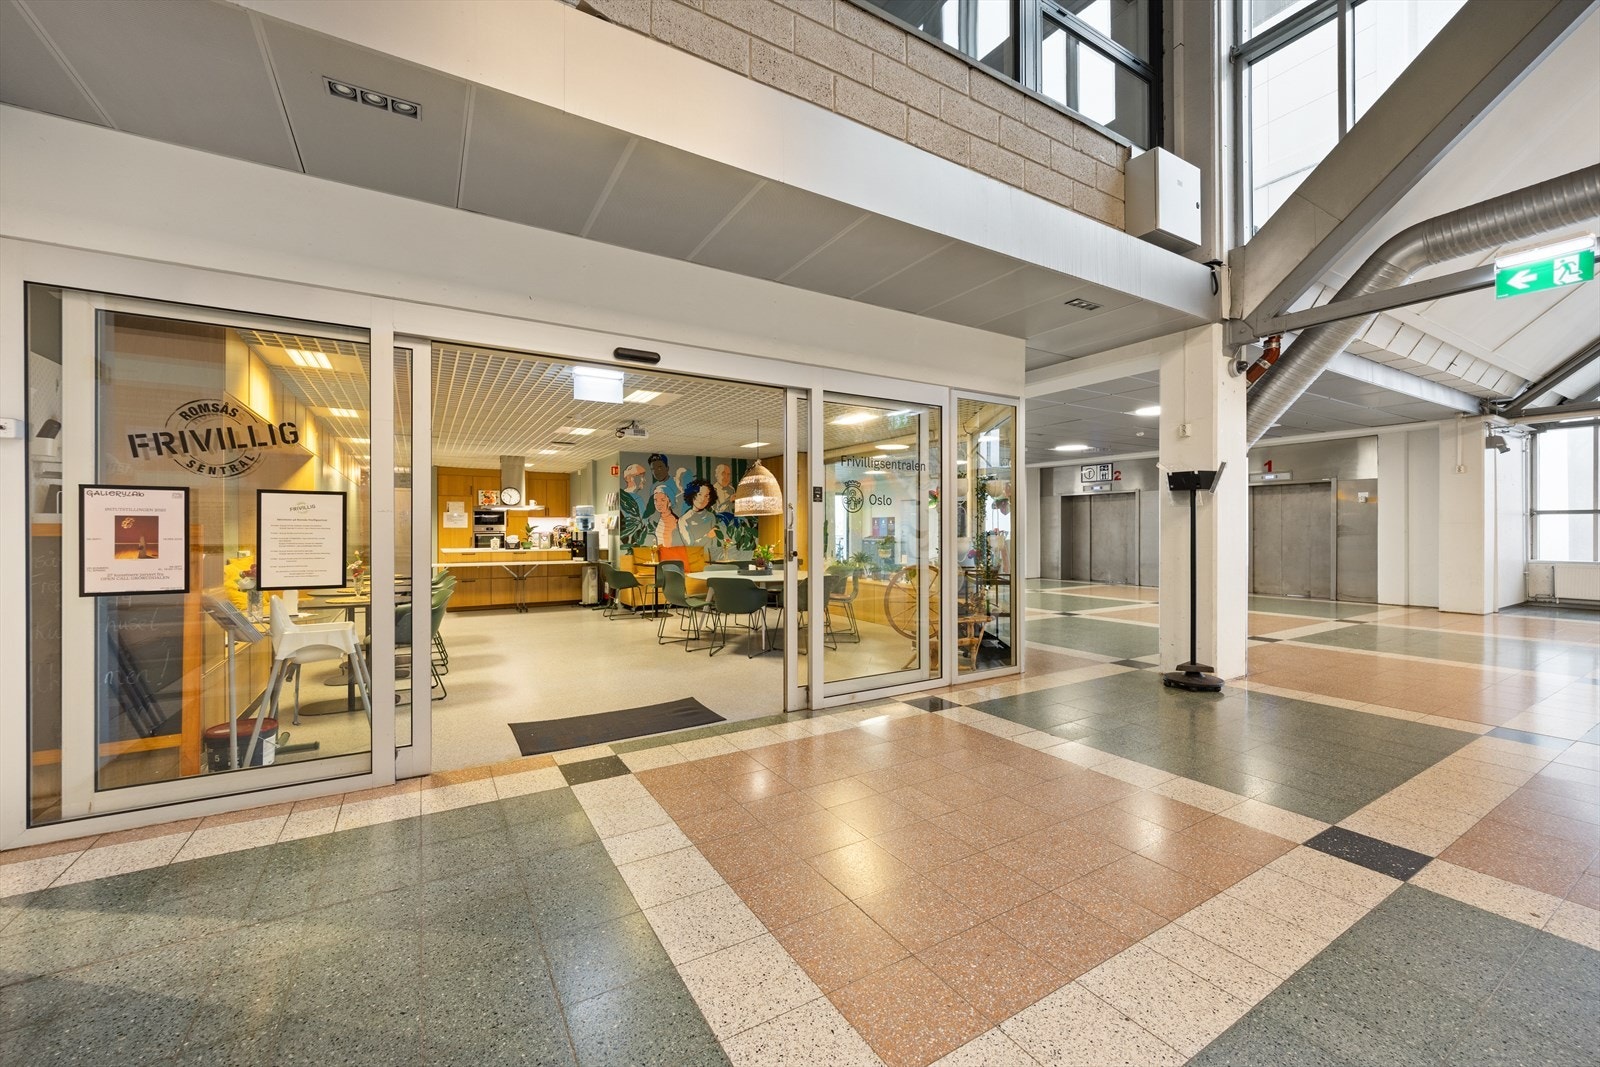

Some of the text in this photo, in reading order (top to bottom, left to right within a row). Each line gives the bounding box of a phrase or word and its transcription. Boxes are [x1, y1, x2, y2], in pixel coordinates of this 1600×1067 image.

[178, 401, 239, 421] ROMSÅS
[127, 422, 299, 458] FRIVILLIG
[185, 454, 256, 475] SENTRAL
[840, 455, 926, 472] Frivilligsentralen
[1263, 460, 1273, 473] 1
[1114, 470, 1122, 481] 2
[289, 503, 316, 511] FRIVILLIG
[869, 493, 892, 506] Oslo
